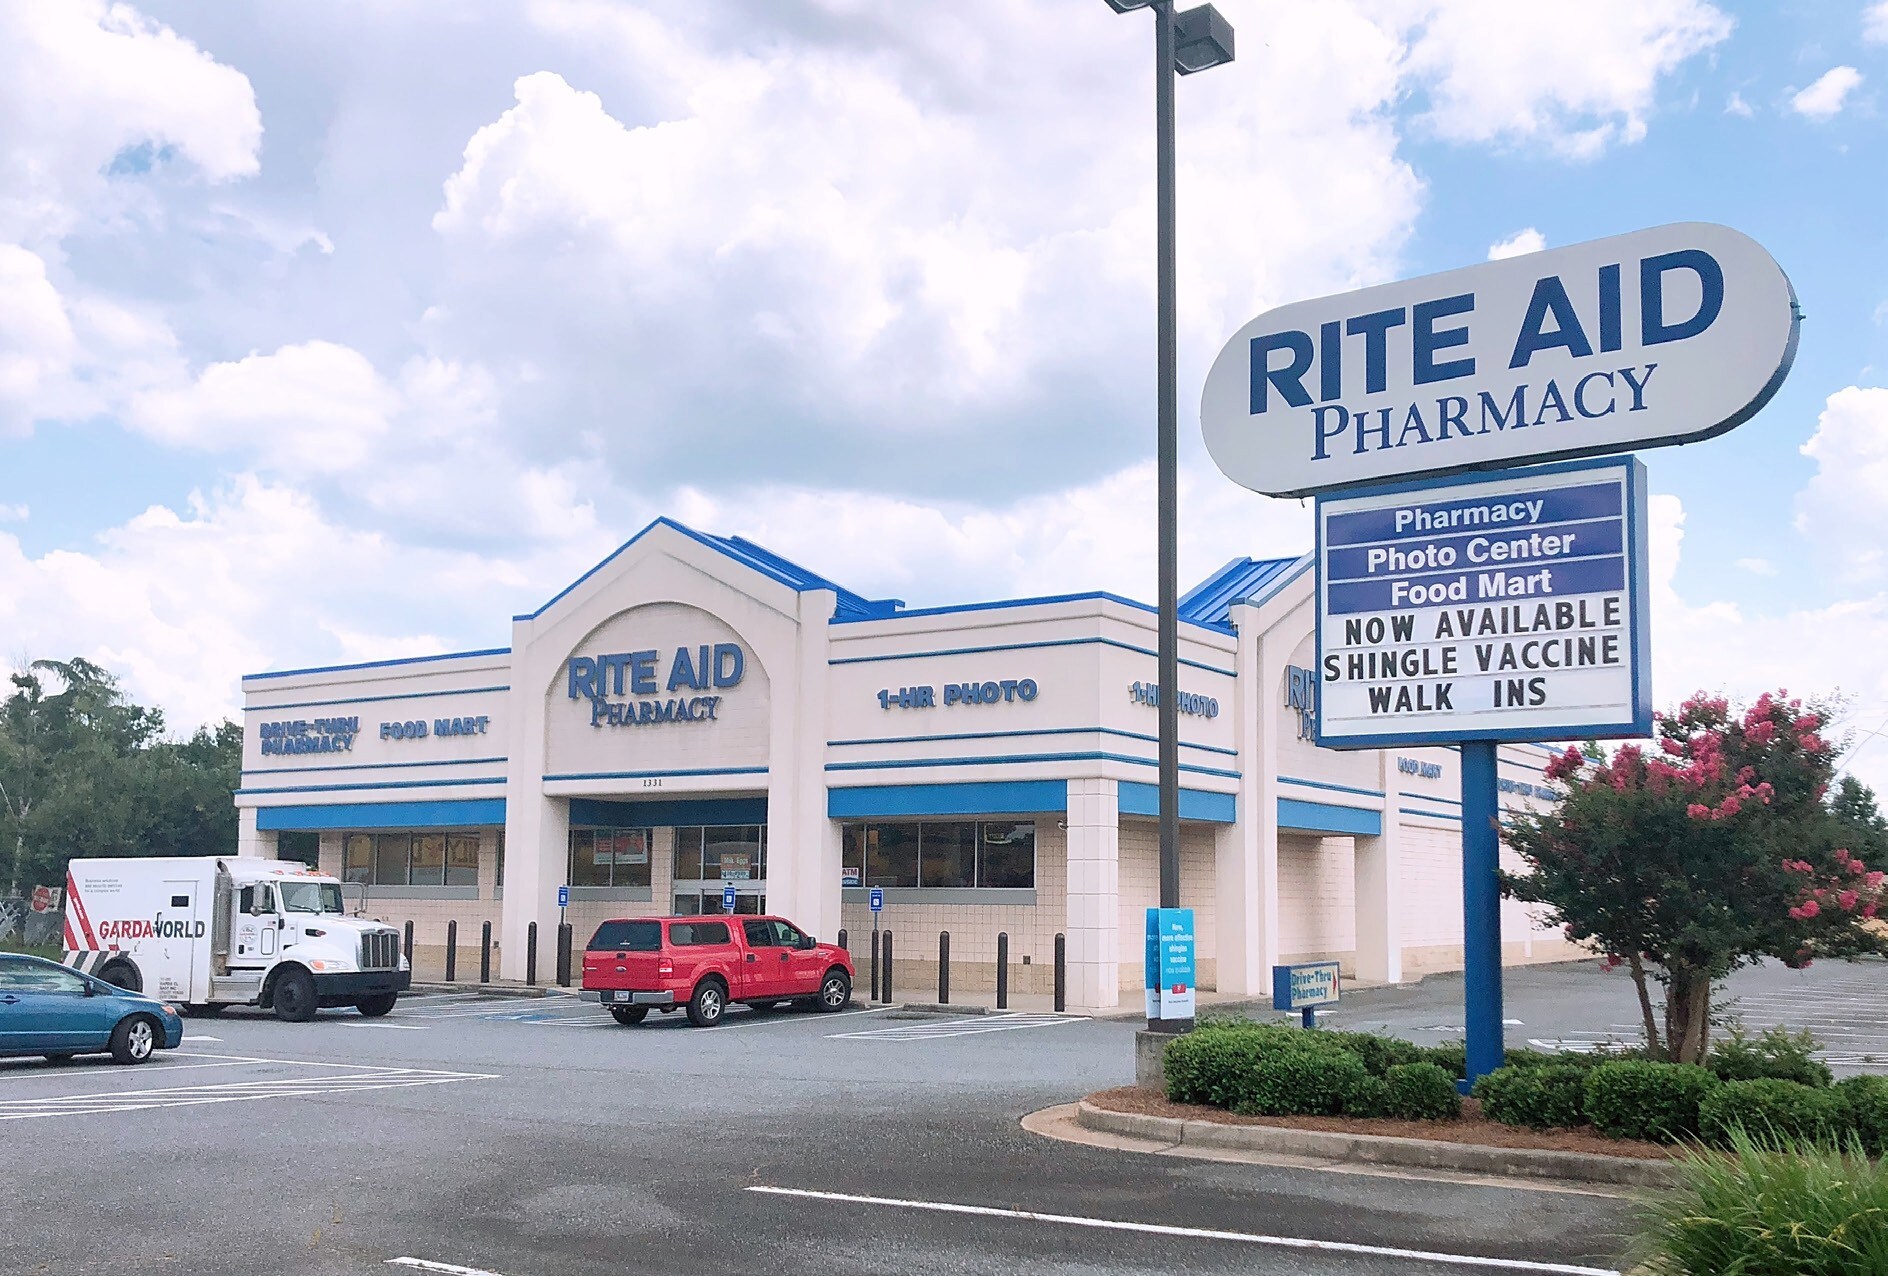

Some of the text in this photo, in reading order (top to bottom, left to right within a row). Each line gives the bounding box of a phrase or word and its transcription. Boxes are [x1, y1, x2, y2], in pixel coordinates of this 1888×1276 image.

[1250, 249, 1725, 415] RITE AID
[1311, 363, 1658, 461] PHARMACY
[1395, 499, 1544, 533] Pharmacy
[1367, 532, 1576, 573] Photo Center
[1391, 569, 1553, 606] Food Mart
[1345, 597, 1621, 646] NOW AVAILABLE
[568, 643, 745, 699] RITE AID
[1324, 634, 1620, 682] SHINGLE VACCINE
[877, 678, 1038, 709] 1-HR PHOTO
[1130, 680, 1160, 707] 1-H
[1285, 665, 1316, 713] RI
[1368, 677, 1547, 714] WALK INS
[260, 716, 360, 738] DRIVE-THRU
[380, 715, 490, 740] FOOD MART
[590, 696, 721, 728] PHARMACY
[261, 734, 355, 755] PHARMACY
[643, 778, 662, 787] 1331
[842, 868, 858, 876] ATM
[99, 920, 206, 939] GARDAWORLD
[1291, 970, 1332, 986] Drive-Thru
[1291, 986, 1328, 1000] Pharmacy
